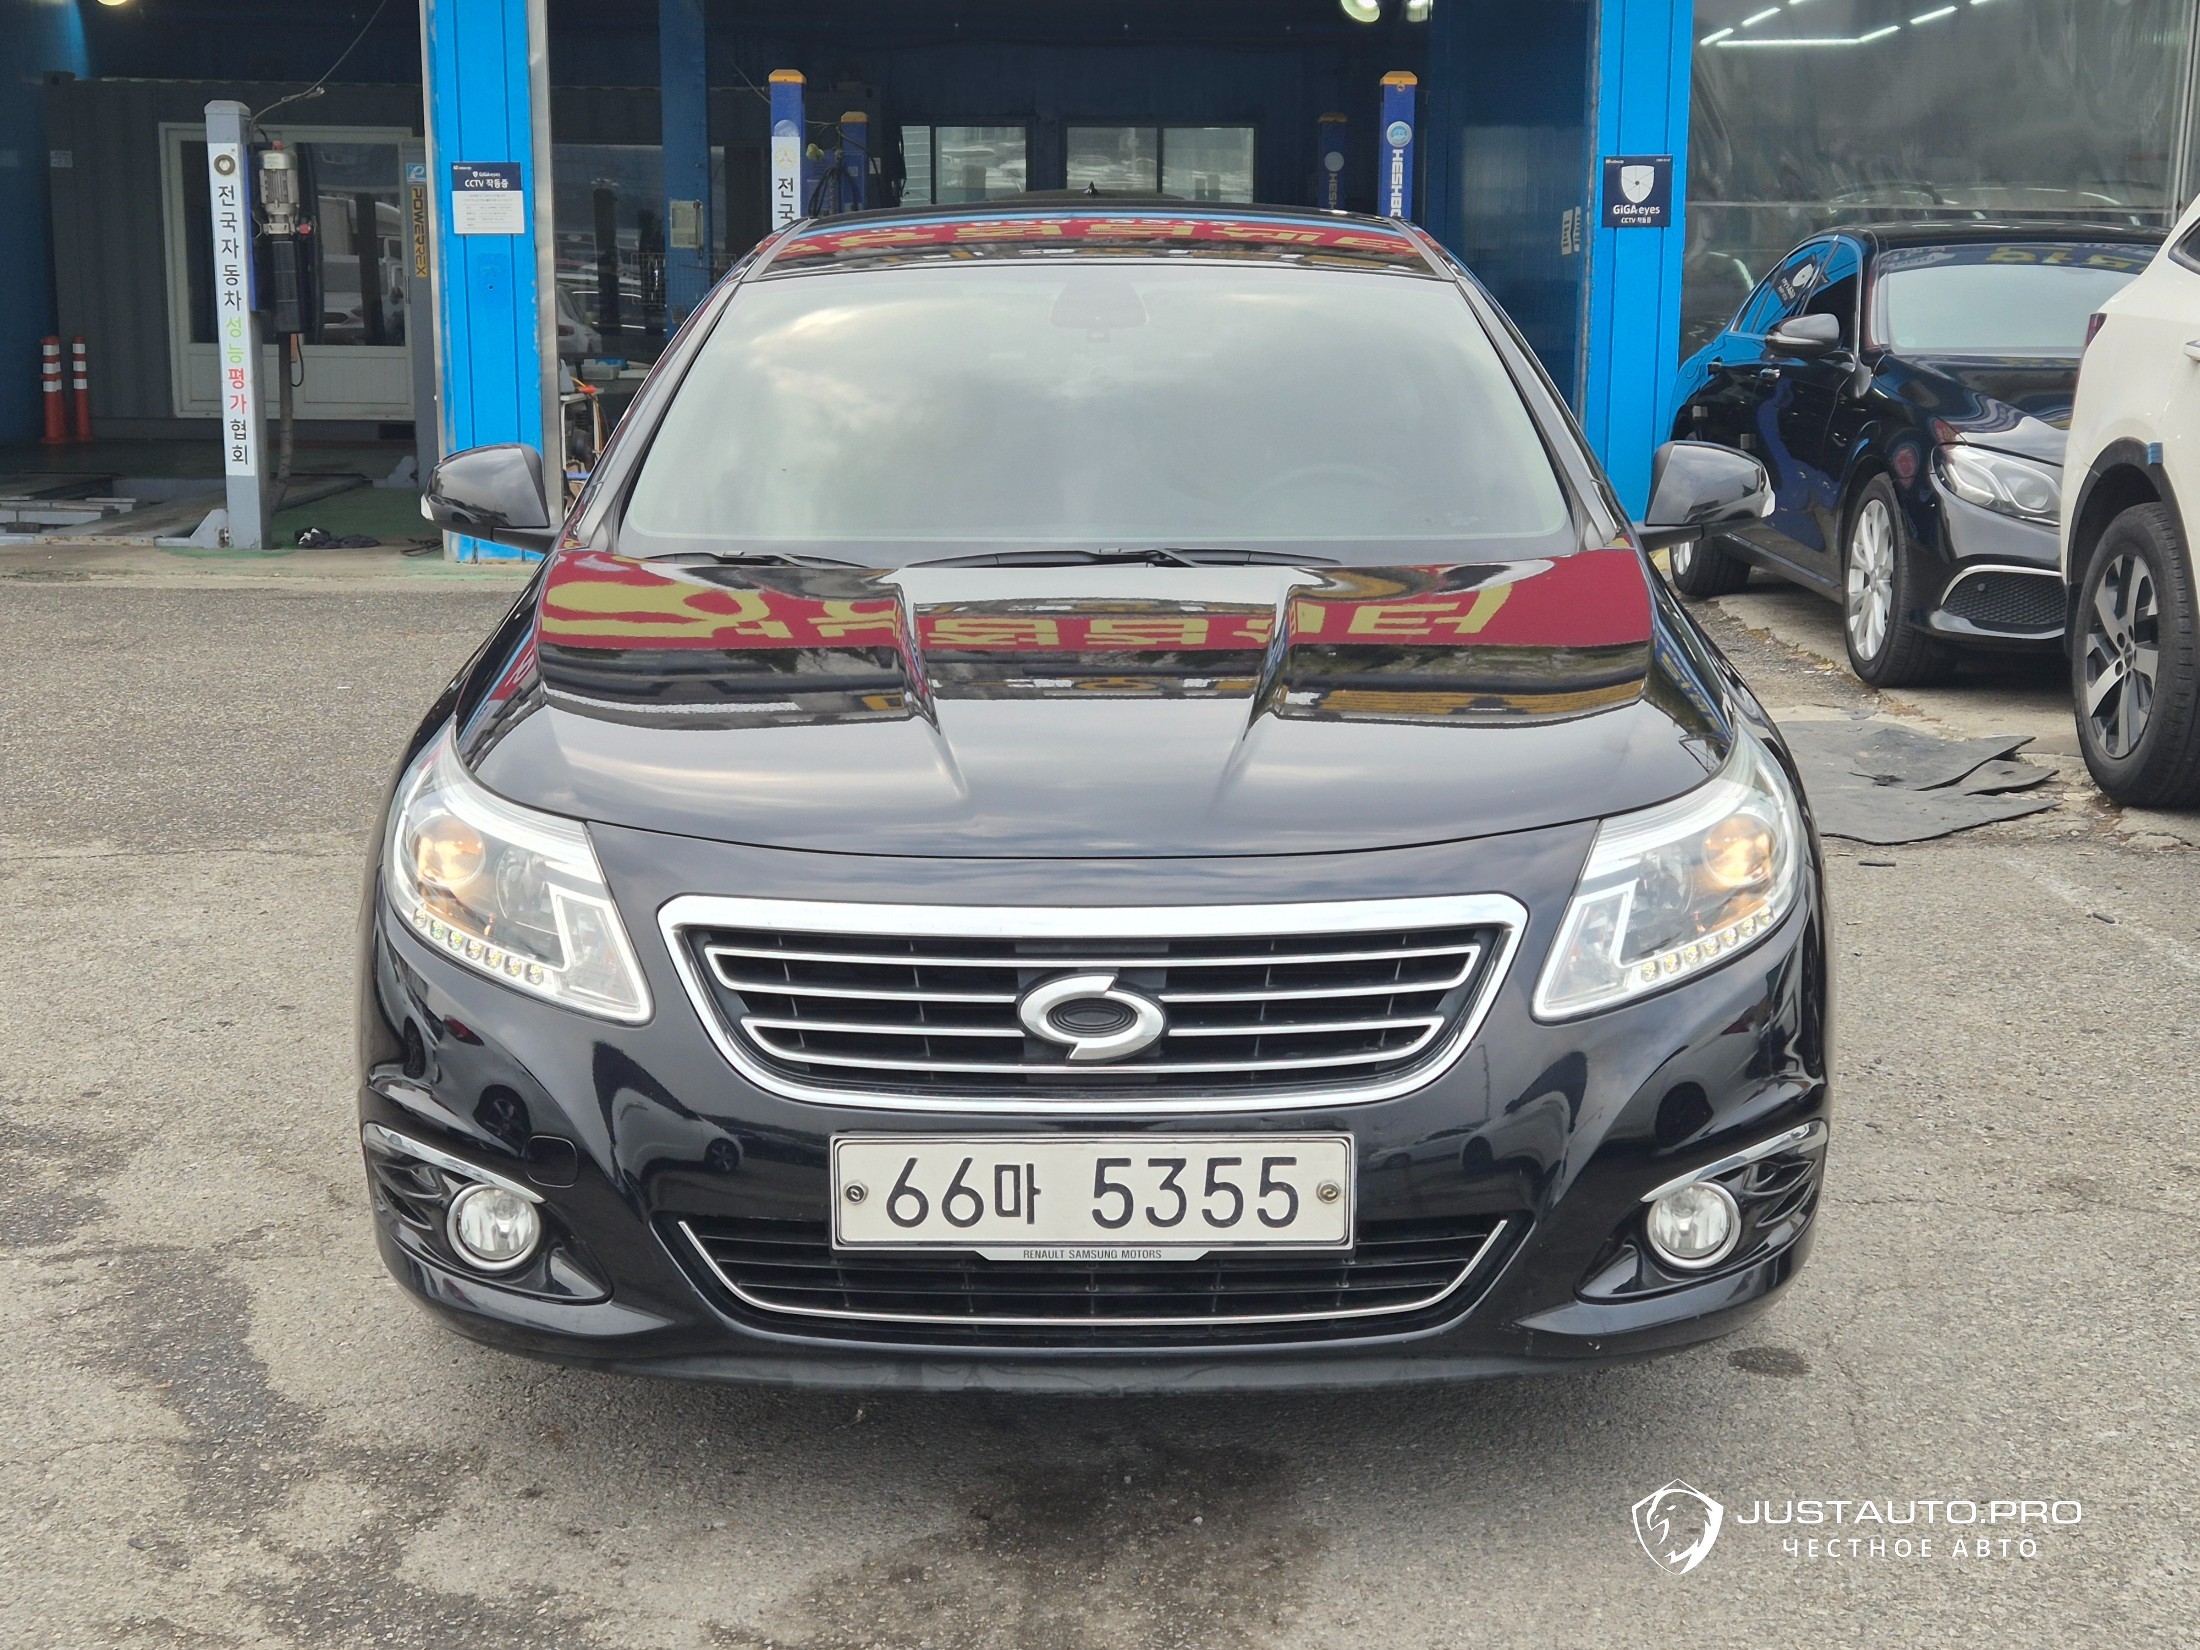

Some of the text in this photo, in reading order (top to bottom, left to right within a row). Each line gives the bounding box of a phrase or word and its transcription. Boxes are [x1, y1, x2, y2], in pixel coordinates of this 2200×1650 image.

[465, 179, 484, 188] CCTV
[886, 1156, 1299, 1228] 66마 5355
[1023, 1249, 1162, 1259] RENAULT SAMSUNG MOTORS
